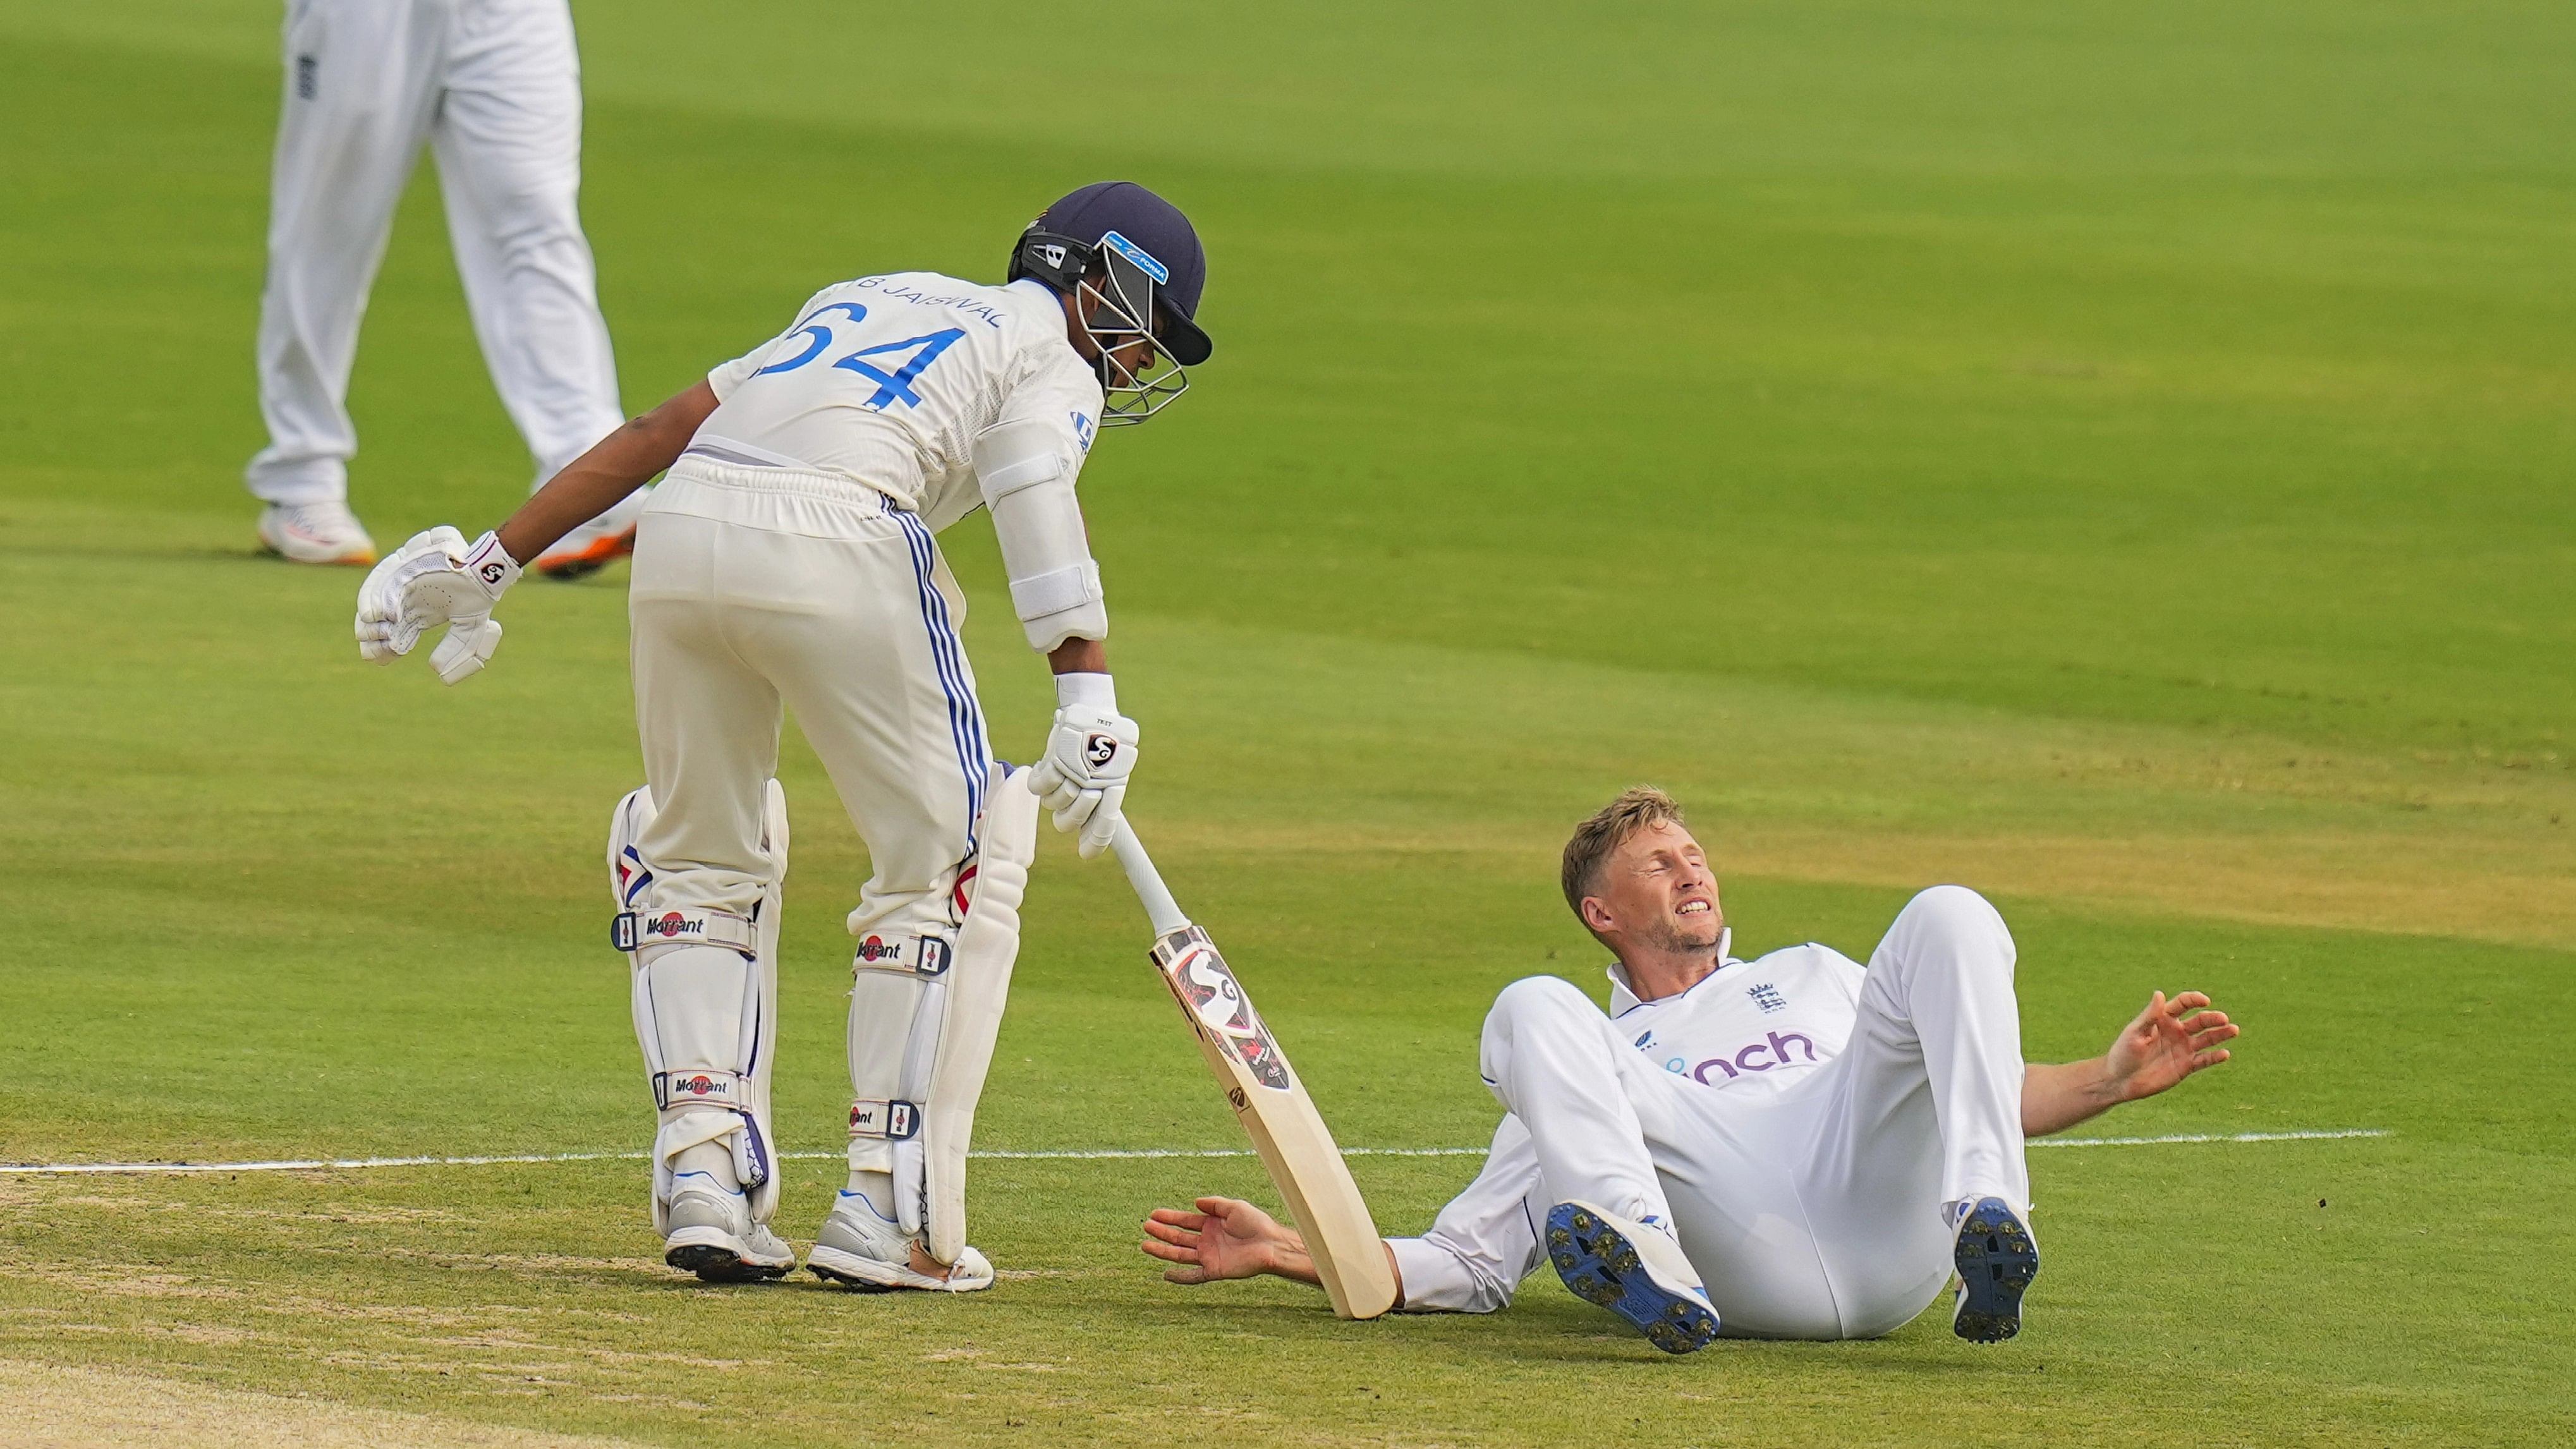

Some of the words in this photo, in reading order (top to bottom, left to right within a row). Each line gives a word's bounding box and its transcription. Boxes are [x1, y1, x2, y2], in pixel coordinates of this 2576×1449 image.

[1139, 257, 1165, 279] FORMA
[883, 287, 1006, 329] JAISWAL
[1097, 718, 1112, 727] TEST
[647, 918, 703, 935] Morrant
[676, 1079, 727, 1094] Morrant
